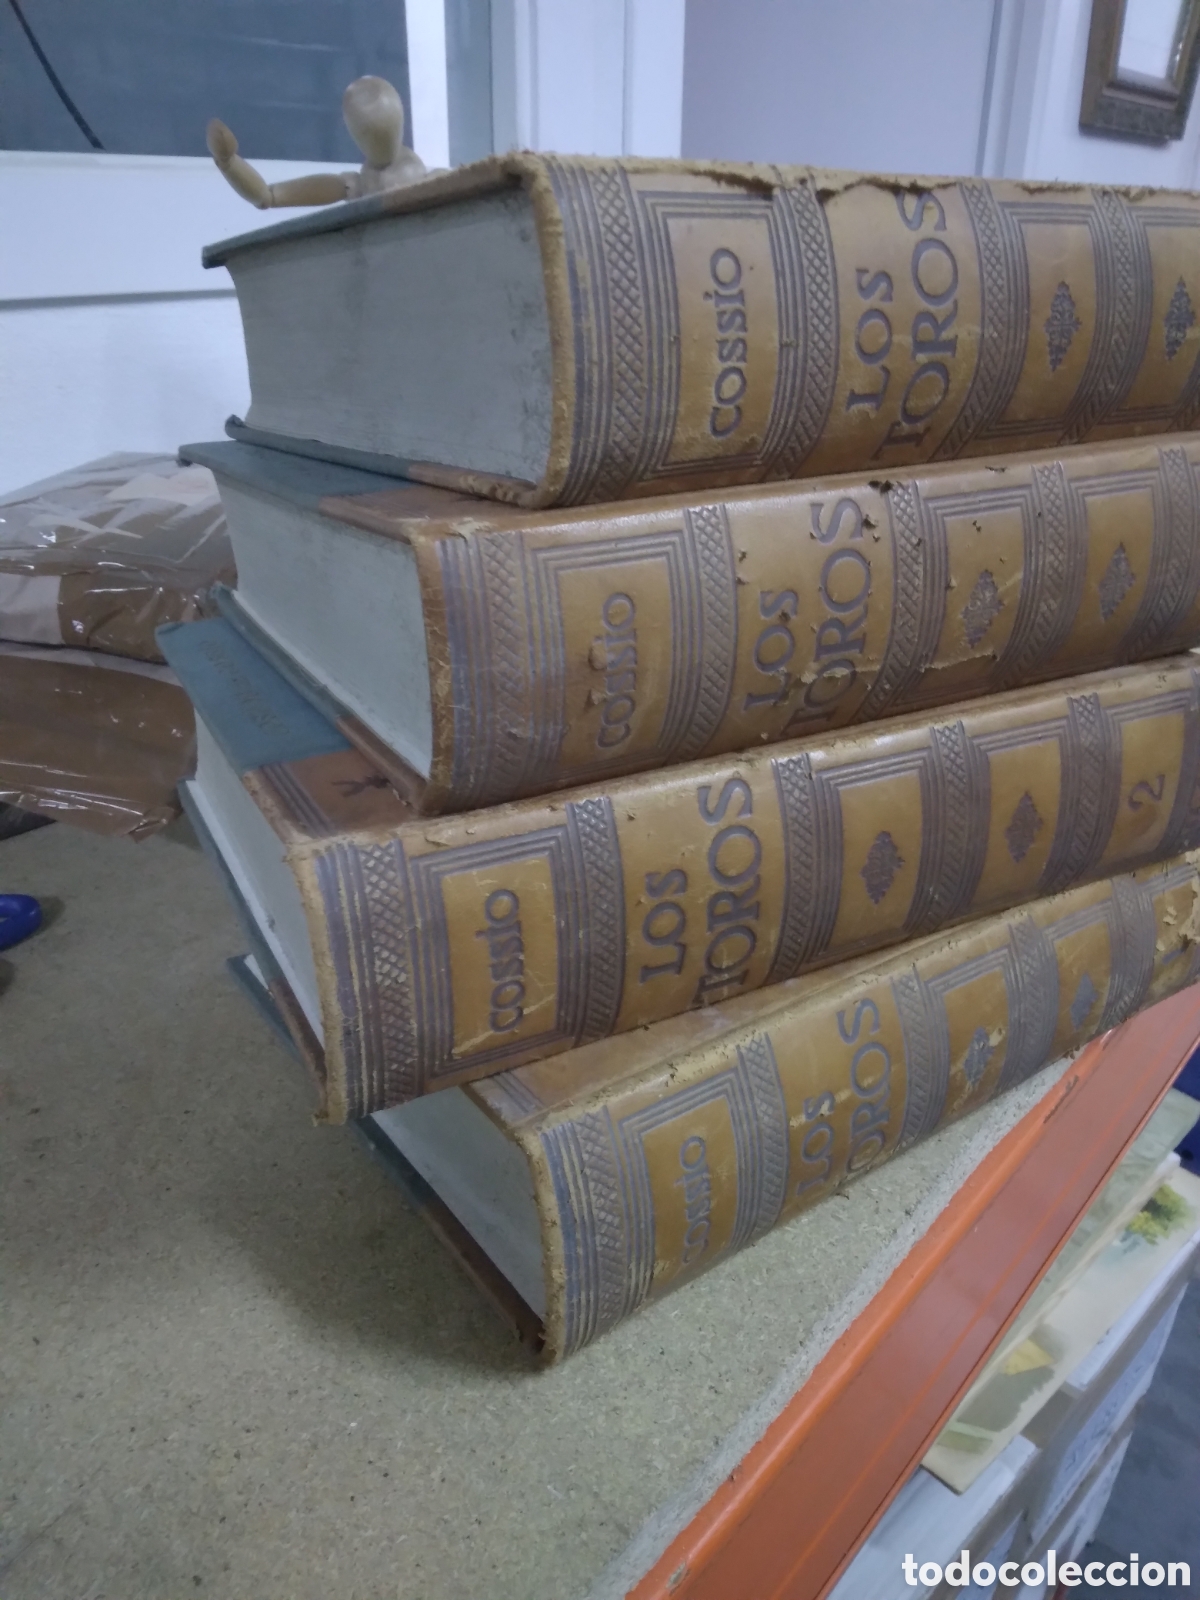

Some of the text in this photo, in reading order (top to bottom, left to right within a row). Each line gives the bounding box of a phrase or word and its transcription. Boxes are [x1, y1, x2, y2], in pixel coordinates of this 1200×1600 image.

[846, 268, 893, 411] LOS
[870, 189, 959, 460] TOROS
[743, 590, 798, 711] LOS
[780, 498, 871, 736] TOROS
[1128, 774, 1166, 812] 2
[639, 868, 688, 985] LOS
[691, 778, 762, 1007] TOROS
[796, 1090, 836, 1195] LOS
[836, 998, 890, 1173] OROS
